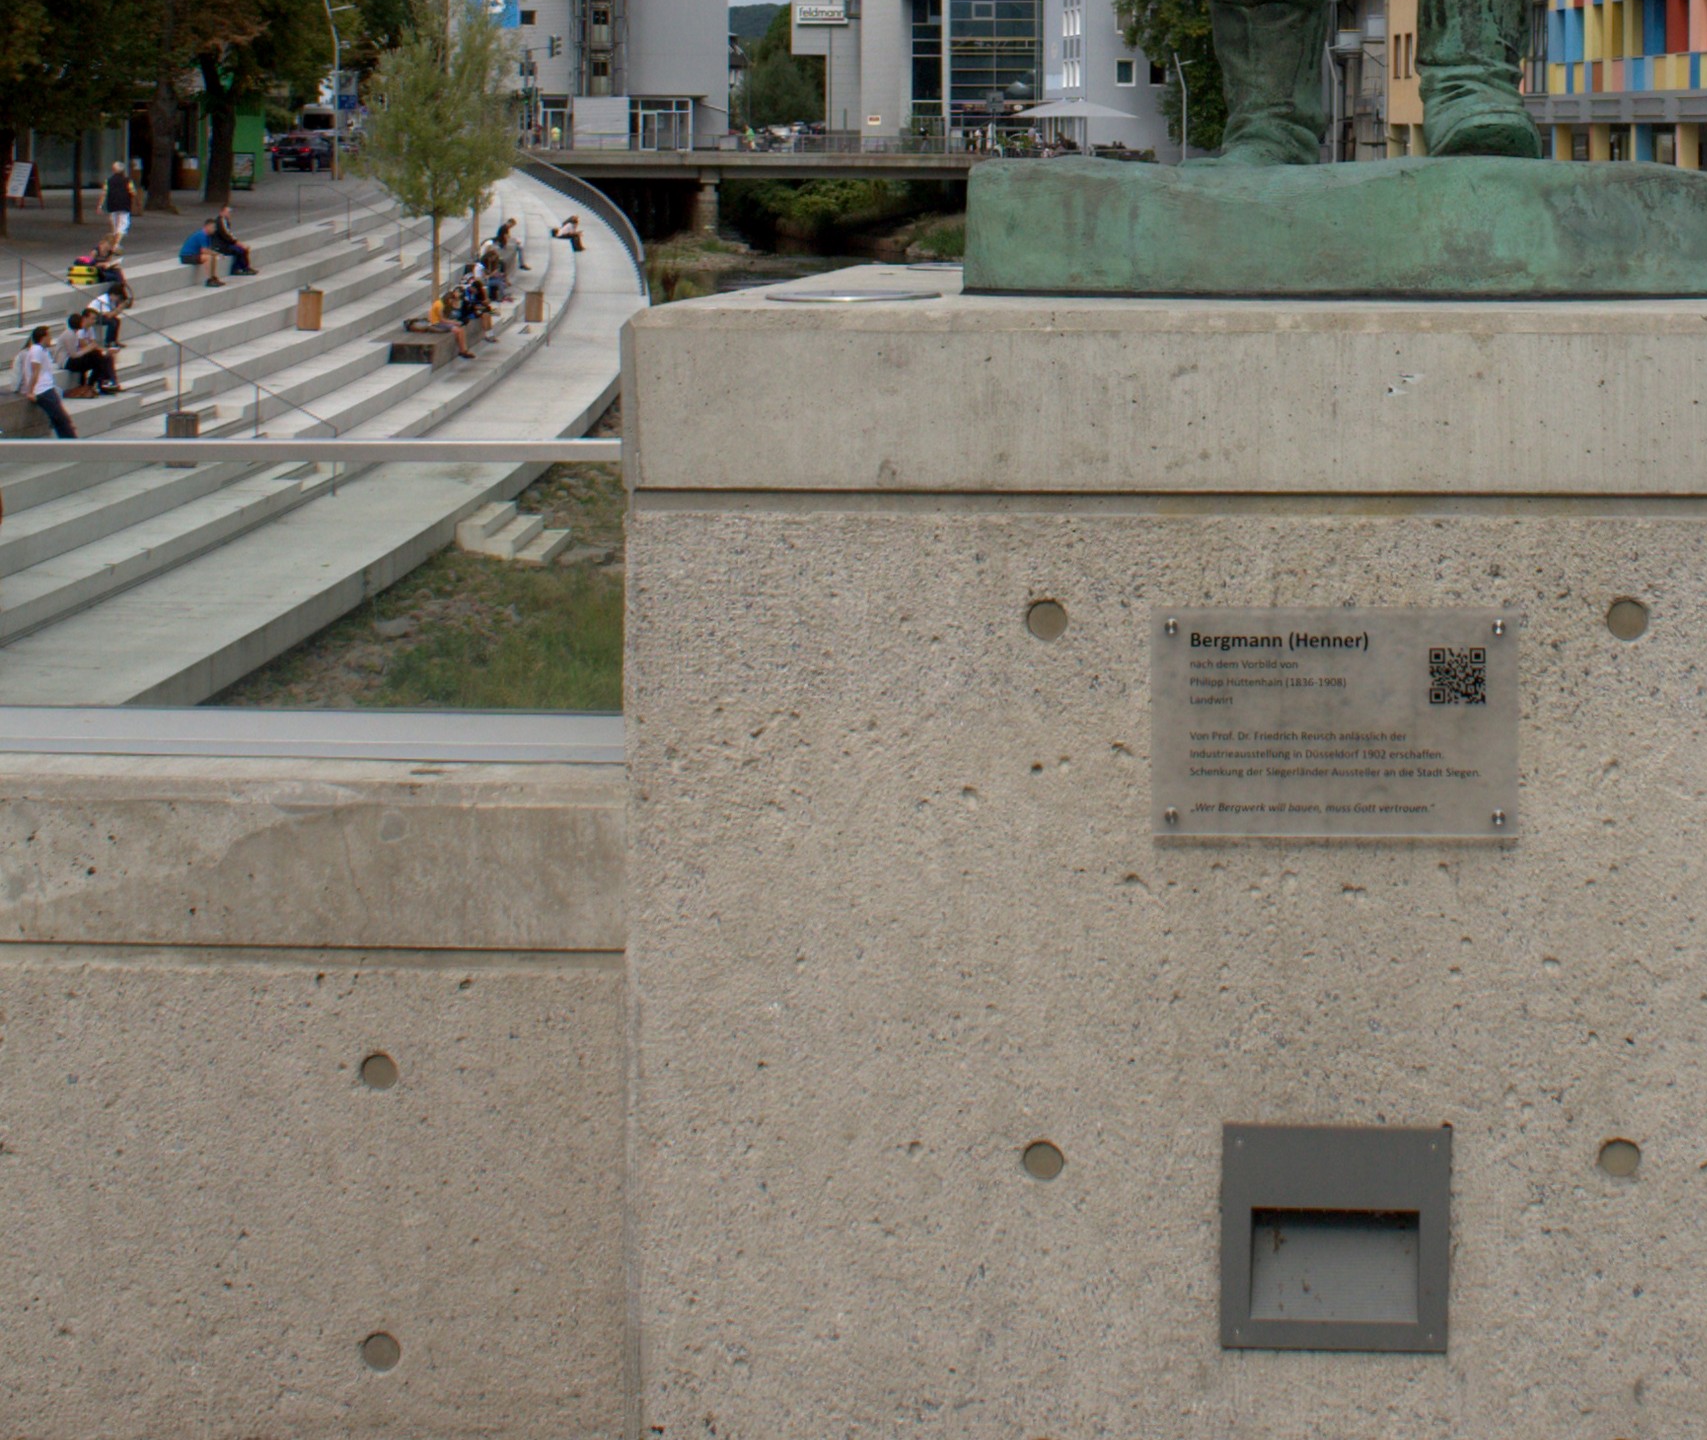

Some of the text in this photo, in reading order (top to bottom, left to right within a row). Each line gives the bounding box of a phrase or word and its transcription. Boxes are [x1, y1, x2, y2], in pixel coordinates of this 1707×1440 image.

[1190, 631, 1369, 652] Bergmann (Henner)
[1190, 659, 1214, 669] nach
[1216, 659, 1239, 669] dem
[1242, 659, 1277, 669] Vorbild
[1190, 677, 1224, 689] Philipp
[1190, 695, 1233, 705] Landwirt
[1190, 731, 1209, 740] Von
[1212, 731, 1234, 740] Prof.
[1254, 731, 1298, 740] Friedrich
[1301, 731, 1336, 740] Reusch
[1390, 731, 1407, 741] der
[1190, 749, 1291, 760] Industrieausstellung
[1293, 749, 1303, 759] in
[1362, 749, 1387, 759] 1902
[1389, 749, 1445, 759] erschaffen.
[1190, 767, 1481, 779] Schenkung der Siegerländer Aussteller an die Stadt Siegen.
[1218, 803, 1266, 814] Bergwerk
[1268, 803, 1287, 812] will
[1325, 805, 1350, 813] muss
[1353, 803, 1376, 813] Gott
